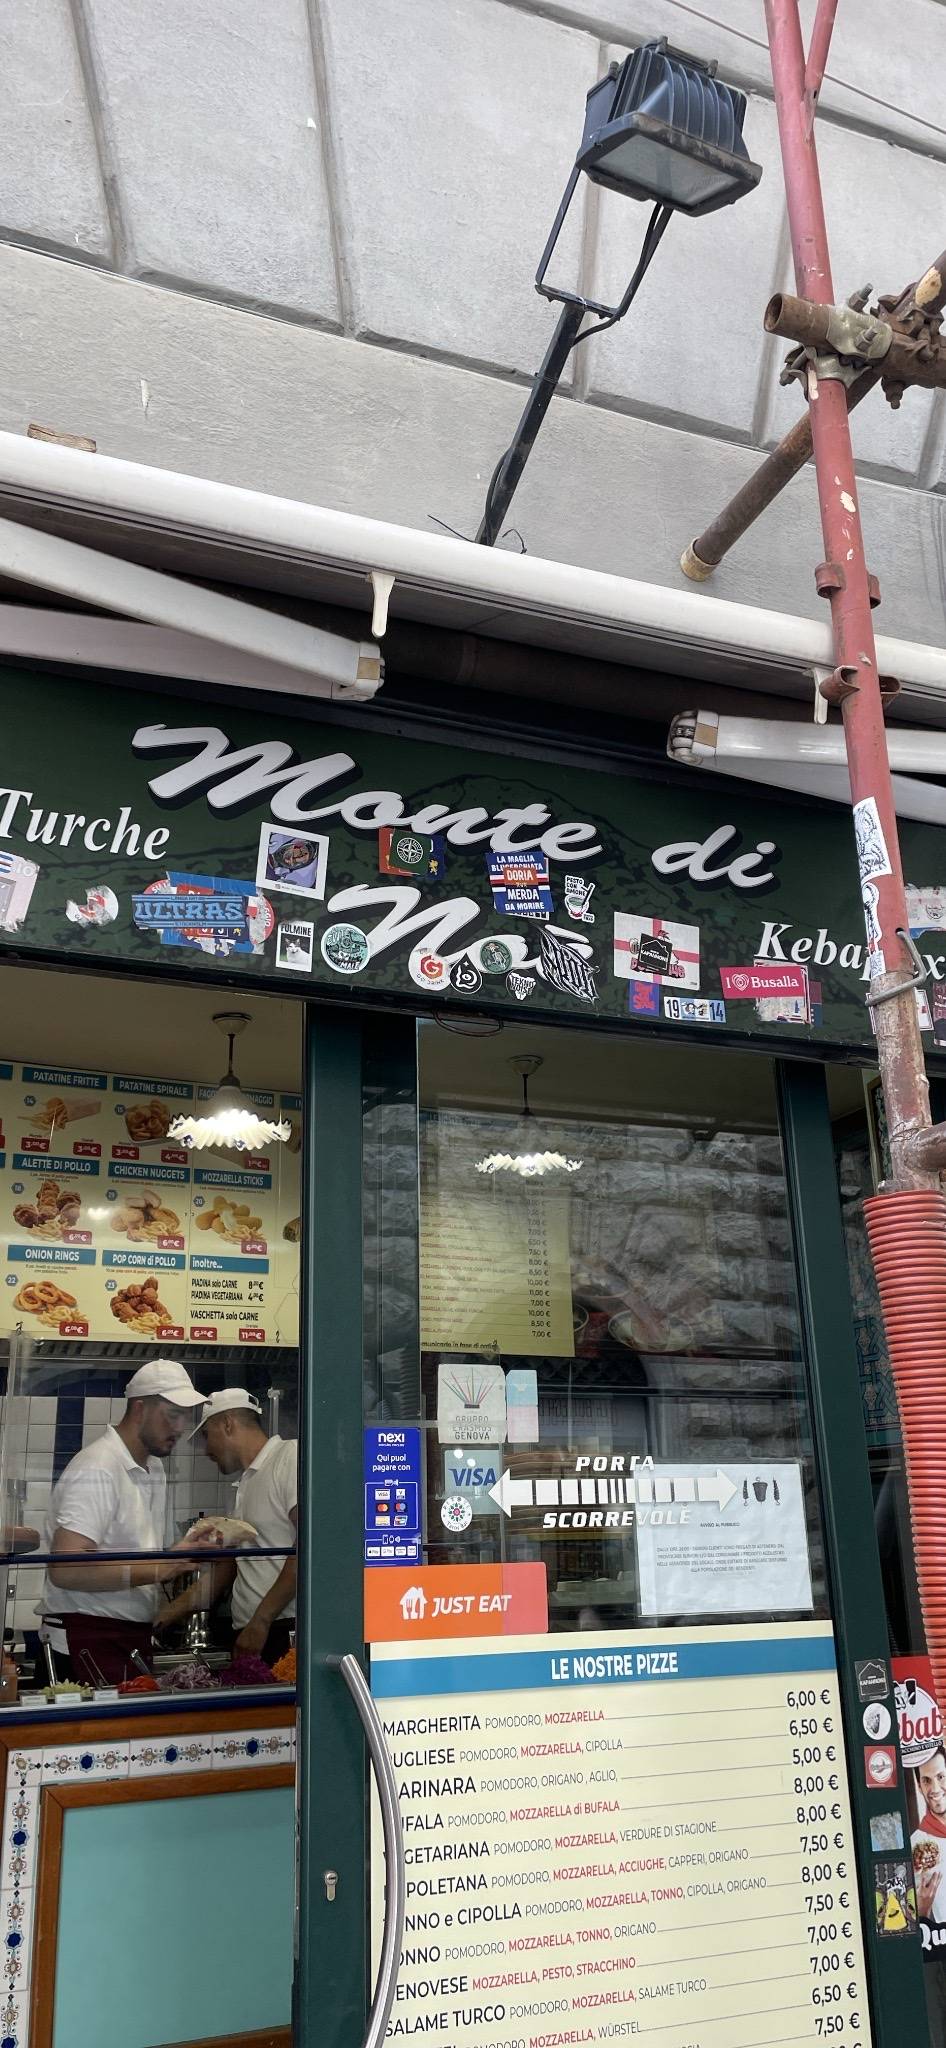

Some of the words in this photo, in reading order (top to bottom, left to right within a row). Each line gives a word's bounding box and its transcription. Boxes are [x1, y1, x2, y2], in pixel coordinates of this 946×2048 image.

[132, 724, 603, 862] Monte
[652, 824, 776, 888] di
[0, 788, 170, 860] Turche
[508, 855, 534, 863] MAGLIA
[507, 869, 533, 881] DORIA
[567, 877, 583, 885] PESTO
[507, 889, 539, 900] MERDA
[135, 902, 243, 920] ULTRAS
[505, 903, 515, 911] DA
[517, 902, 544, 910] MORIRE
[280, 923, 312, 936] FULMINE
[751, 975, 800, 989] Busalla
[667, 999, 680, 1019] 19
[709, 1002, 724, 1022] 14
[33, 1071, 72, 1084] PATATINE
[73, 1076, 100, 1087] FRITTE
[119, 1080, 156, 1092] PATATINE
[157, 1084, 188, 1096] SPIRALE
[22, 1157, 52, 1169] ALETTE
[53, 1160, 63, 1170] DI
[64, 1161, 91, 1172] POLLO
[114, 1165, 149, 1176] CHICKEN
[150, 1167, 185, 1180] NUGGETS
[202, 1172, 242, 1184] MOZZARELLA
[243, 1175, 264, 1186] STICKS
[25, 1248, 53, 1260] ONION
[54, 1250, 80, 1261] RINGS
[112, 1254, 127, 1264] POP
[127, 1254, 147, 1265] CORN
[147, 1255, 155, 1265] di
[155, 1256, 176, 1267] POLLO
[192, 1257, 223, 1269] inoltre...
[191, 1278, 211, 1288] PIADINA
[211, 1280, 221, 1288] solo
[222, 1280, 238, 1289] CARNE
[191, 1290, 211, 1300] PIADINA
[212, 1291, 243, 1301] VEGETARIANA
[190, 1310, 225, 1320] VASCHETTA
[226, 1311, 238, 1320] solo
[239, 1312, 259, 1321] CARNE
[377, 1432, 405, 1443] nexi
[454, 1432, 490, 1441] GENOVA
[376, 1453, 390, 1463] Qui
[390, 1453, 407, 1463] puoi
[575, 1455, 655, 1472] PORTA
[372, 1464, 397, 1473] pagare
[448, 1467, 496, 1487] VISA
[543, 1509, 692, 1529] SCORREVOLE
[432, 1596, 476, 1617] JUST
[479, 1594, 512, 1613] EAT
[551, 1657, 570, 1680] LE
[573, 1652, 633, 1678] NOSTRE
[636, 1652, 679, 1676] PIZZE
[383, 1715, 481, 1737] MARGHERITA
[485, 1714, 543, 1729] POMODORO,
[545, 1710, 604, 1725] MOZZARELLA
[787, 1690, 816, 1710] 6,00
[820, 1689, 831, 1705] €
[900, 1707, 944, 1744] bab
[391, 1748, 456, 1768] UGLIESE
[459, 1748, 519, 1763] POMODORO,
[520, 1743, 584, 1758] MOZZARELLA,
[585, 1738, 623, 1753] CIPOLLA
[789, 1719, 818, 1738] 6,50
[823, 1717, 834, 1733] €
[399, 1776, 477, 1800] ARINARA
[480, 1777, 540, 1792] POMODORO,
[589, 1769, 618, 1783] AGLIO,
[792, 1747, 822, 1767] 5,00
[825, 1745, 836, 1762] €
[400, 1813, 444, 1833] FALA
[448, 1810, 508, 1827] POMODORO,
[510, 1804, 572, 1821] MOZZARELLA
[574, 1802, 583, 1815] di
[584, 1800, 620, 1814] BUFALA
[794, 1775, 824, 1796] 8,00
[828, 1774, 839, 1791] €
[404, 1841, 490, 1865] GETARIANA
[494, 1838, 553, 1855] POMODORO,
[555, 1831, 618, 1849] MOZZARELLA,
[620, 1826, 662, 1842] VERDURE
[663, 1824, 674, 1837] DI
[674, 1821, 717, 1836] STAGIONE
[796, 1804, 827, 1826] 8,00
[830, 1803, 842, 1820] €
[406, 1873, 488, 1898] POLETANA
[491, 1870, 551, 1888] POMODORO,
[553, 1863, 617, 1881] MOZZARELLA,
[619, 1857, 667, 1874] ACCIUGHE,
[668, 1852, 708, 1868] CAPPERI,
[708, 1848, 749, 1864] ORIGANO
[800, 1834, 828, 1855] 7,50
[833, 1832, 844, 1849] €
[404, 1913, 440, 1932] NNO
[444, 1914, 453, 1927] e
[457, 1902, 522, 1925] CIPOLLA
[525, 1898, 585, 1917] POMODORO,
[586, 1888, 650, 1909] MOZZARELLA,
[651, 1887, 686, 1902] TONNO,
[687, 1882, 726, 1898] CIPOLLA,
[727, 1877, 767, 1893] ORIGANO
[801, 1863, 832, 1885] 8,00
[836, 1862, 847, 1879] €
[445, 1941, 508, 1961] POMODORO,
[508, 1933, 575, 1952] MOZZARELLA,
[576, 1927, 613, 1943] TONNO,
[614, 1921, 657, 1938] ORIGANO
[805, 1893, 834, 1915] 7,50
[838, 1892, 850, 1909] €
[396, 1975, 468, 2001] ENOVESE
[472, 1970, 540, 1990] MOZZARELLA,
[542, 1965, 575, 1982] PESTO,
[576, 1956, 636, 1976] STRACCHINO
[807, 1923, 837, 1946] 7,00
[841, 1921, 853, 1938] €
[385, 2012, 449, 2038] SALAME
[452, 2004, 506, 2028] TURCO
[509, 1999, 571, 2020] POMODORO,
[572, 1989, 637, 2010] MOZZARELLA,
[638, 1983, 675, 2000] SALAME
[676, 1978, 707, 1994] TURCO
[810, 1953, 840, 1976] 7,00
[844, 1951, 855, 1969] €
[529, 2028, 597, 2048] MOZZARELLA,
[598, 2021, 641, 2039] WÜRSTEL
[812, 1984, 842, 2007] 6,50
[846, 1981, 858, 1999] €
[815, 2014, 844, 2037] 7,50
[849, 2012, 860, 2030] €
